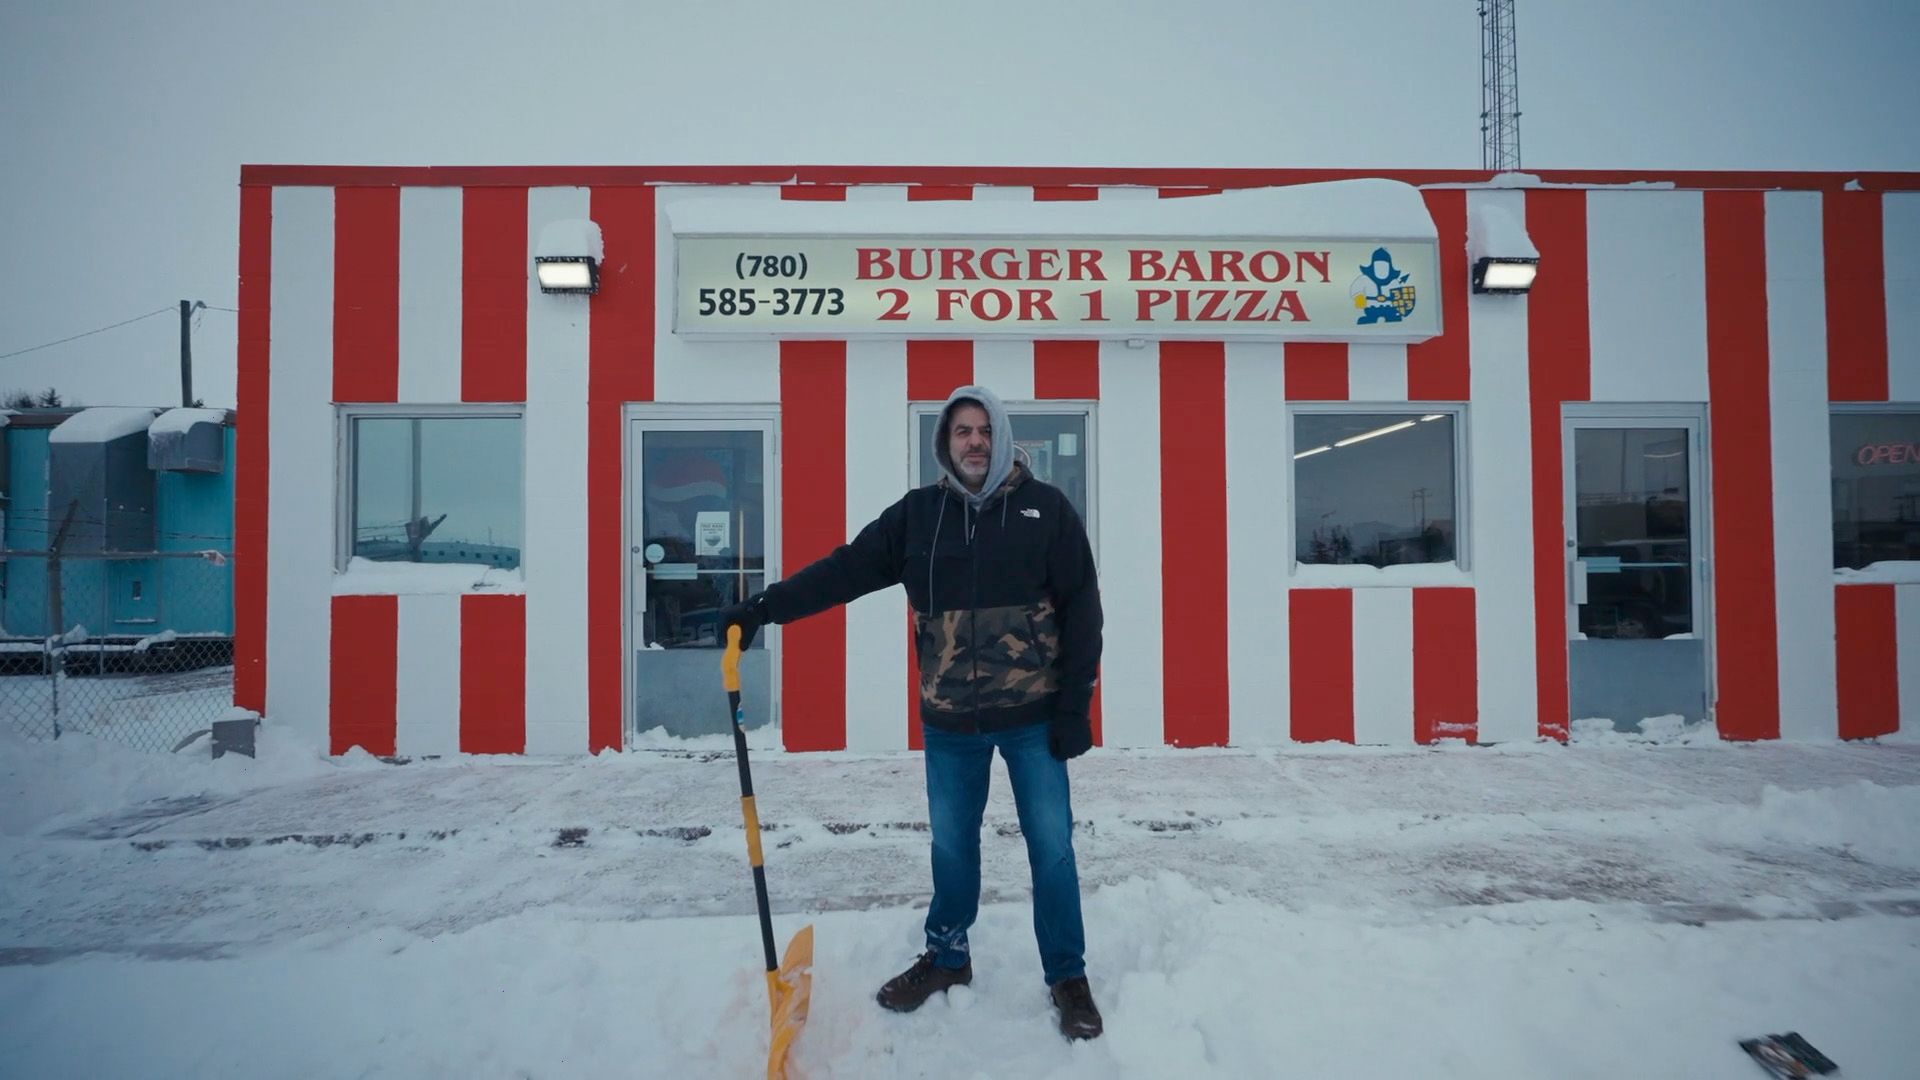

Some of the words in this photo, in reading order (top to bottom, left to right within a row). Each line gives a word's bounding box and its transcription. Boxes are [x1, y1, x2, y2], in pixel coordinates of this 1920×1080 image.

[736, 253, 807, 280] (780)
[857, 248, 1106, 281] BURGER
[1130, 249, 1330, 282] BARON
[699, 288, 844, 316] 585-3773
[877, 288, 910, 320] 2
[937, 288, 1056, 321] FOR
[1081, 289, 1110, 321] 1
[1137, 289, 1309, 321] PIZZA
